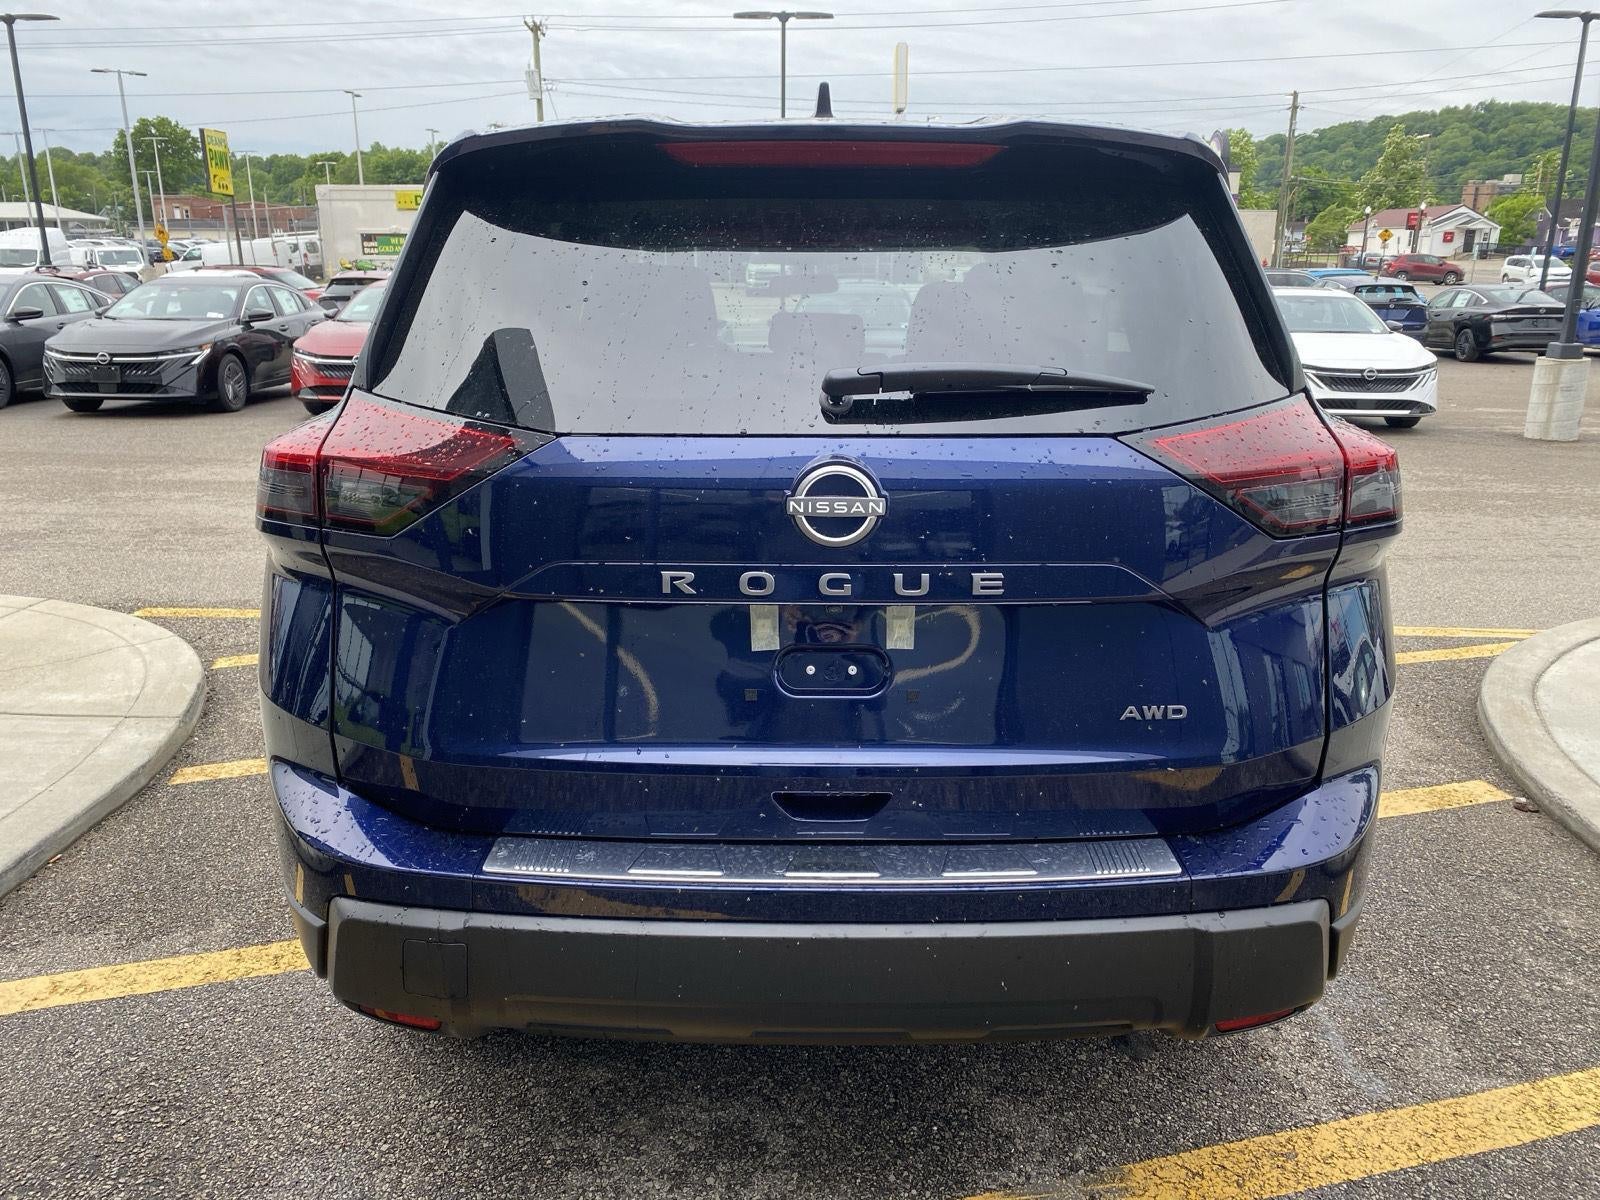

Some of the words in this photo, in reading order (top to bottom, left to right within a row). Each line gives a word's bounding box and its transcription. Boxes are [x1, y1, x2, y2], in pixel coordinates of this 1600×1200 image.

[208, 148, 229, 171] PAWN
[789, 499, 884, 514] NISSAN
[660, 570, 1005, 597] ROGUE
[1119, 704, 1188, 721] AWD
